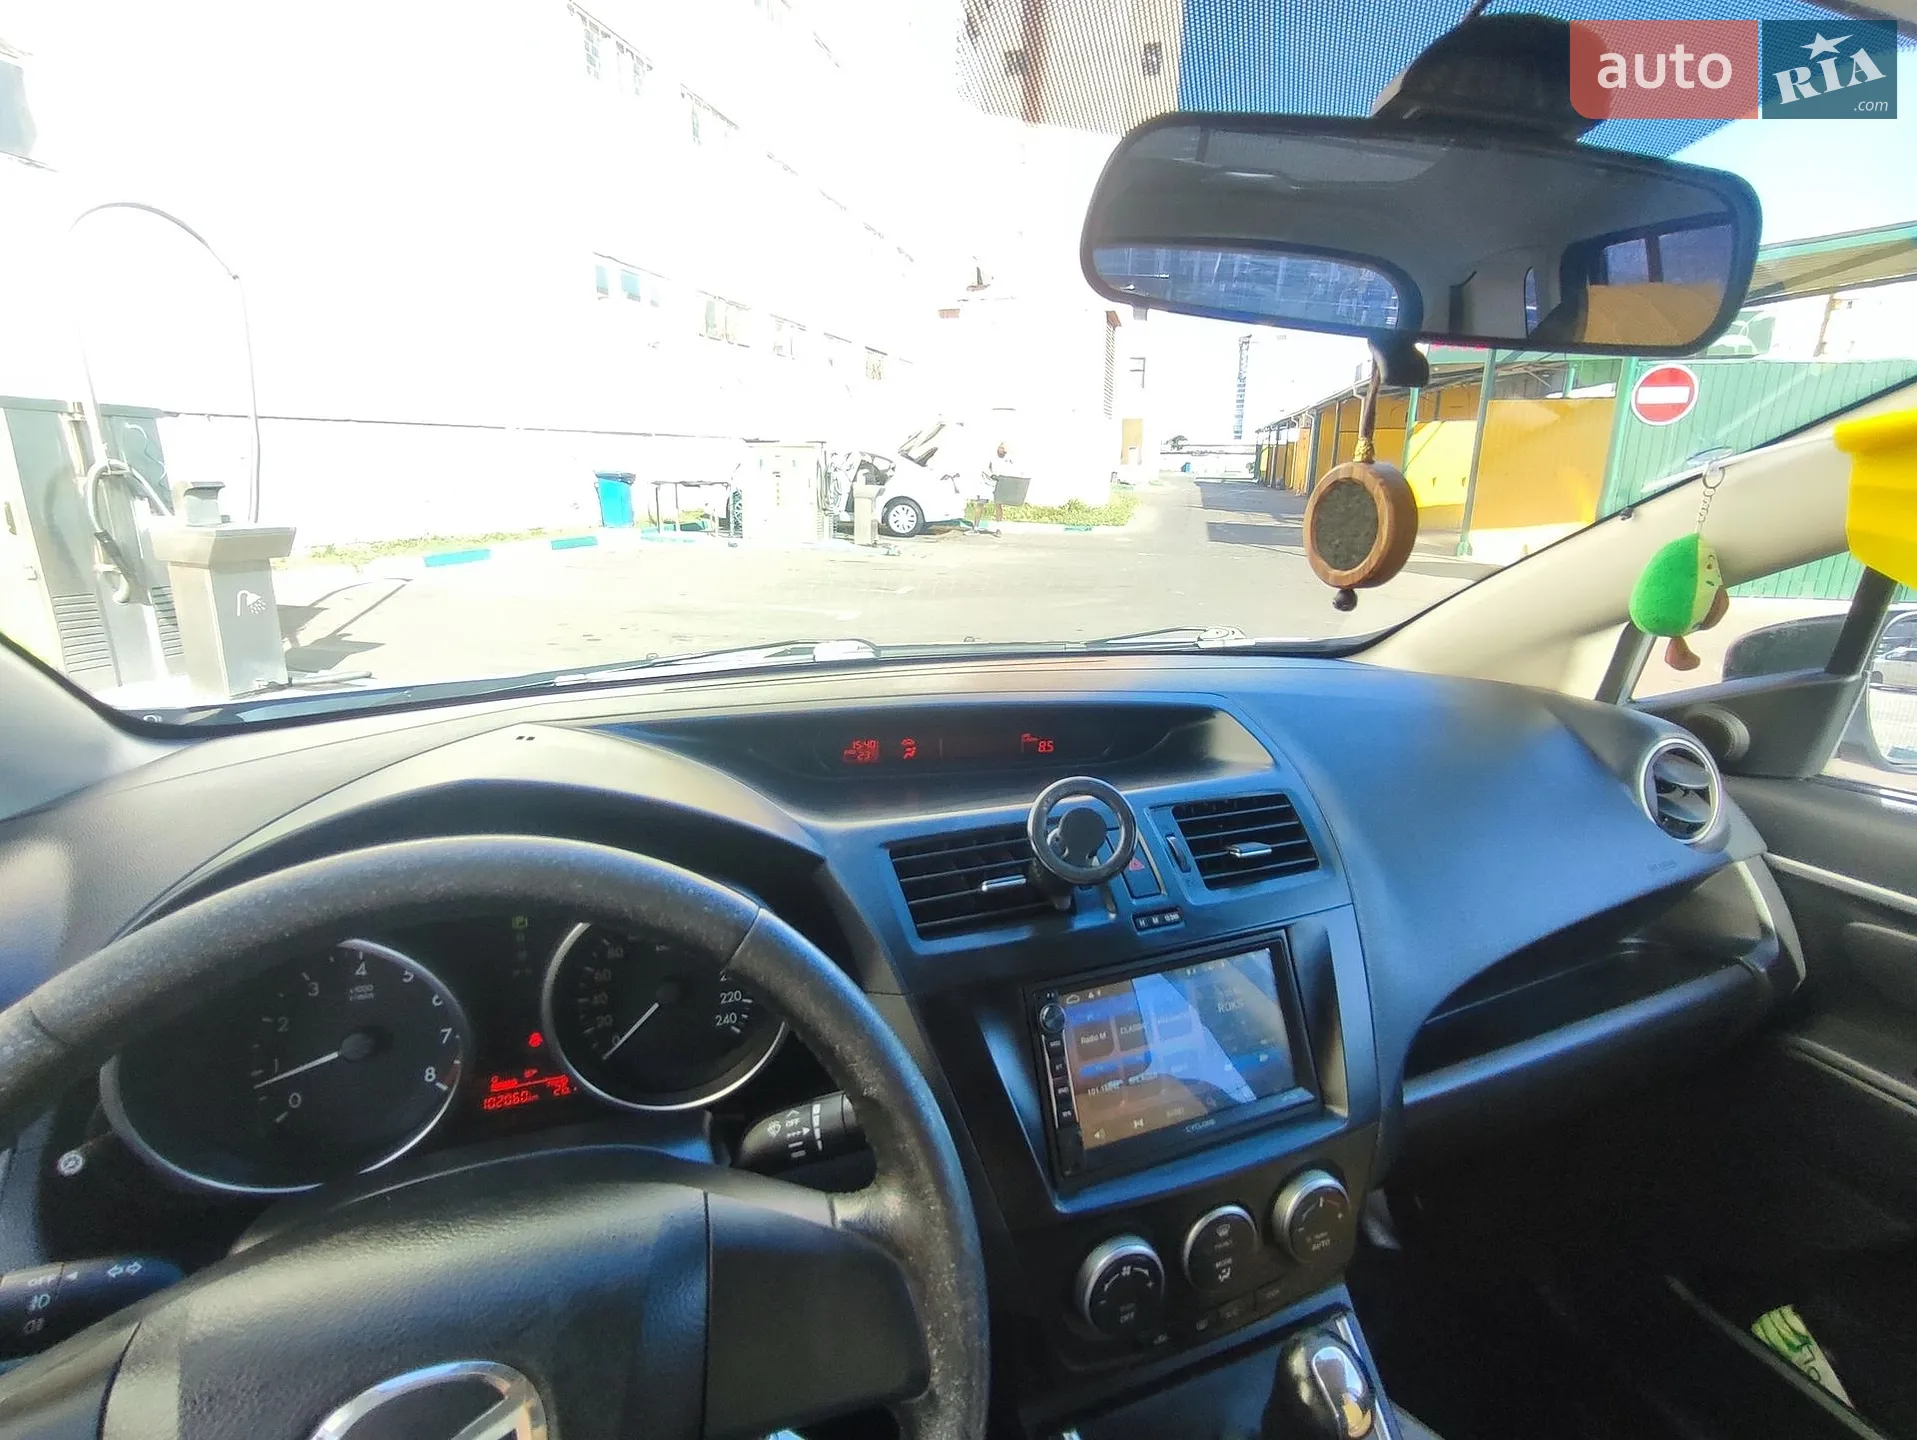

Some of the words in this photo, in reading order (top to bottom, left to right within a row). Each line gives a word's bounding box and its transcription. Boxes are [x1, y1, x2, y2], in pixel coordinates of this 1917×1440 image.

[355, 961, 367, 976] 4
[307, 982, 320, 997] 3
[720, 990, 742, 1004] 220
[277, 1017, 289, 1032] 2
[715, 1012, 738, 1027] 240
[440, 1027, 452, 1044] 7
[424, 1066, 436, 1082] 8
[289, 1092, 302, 1108] 0
